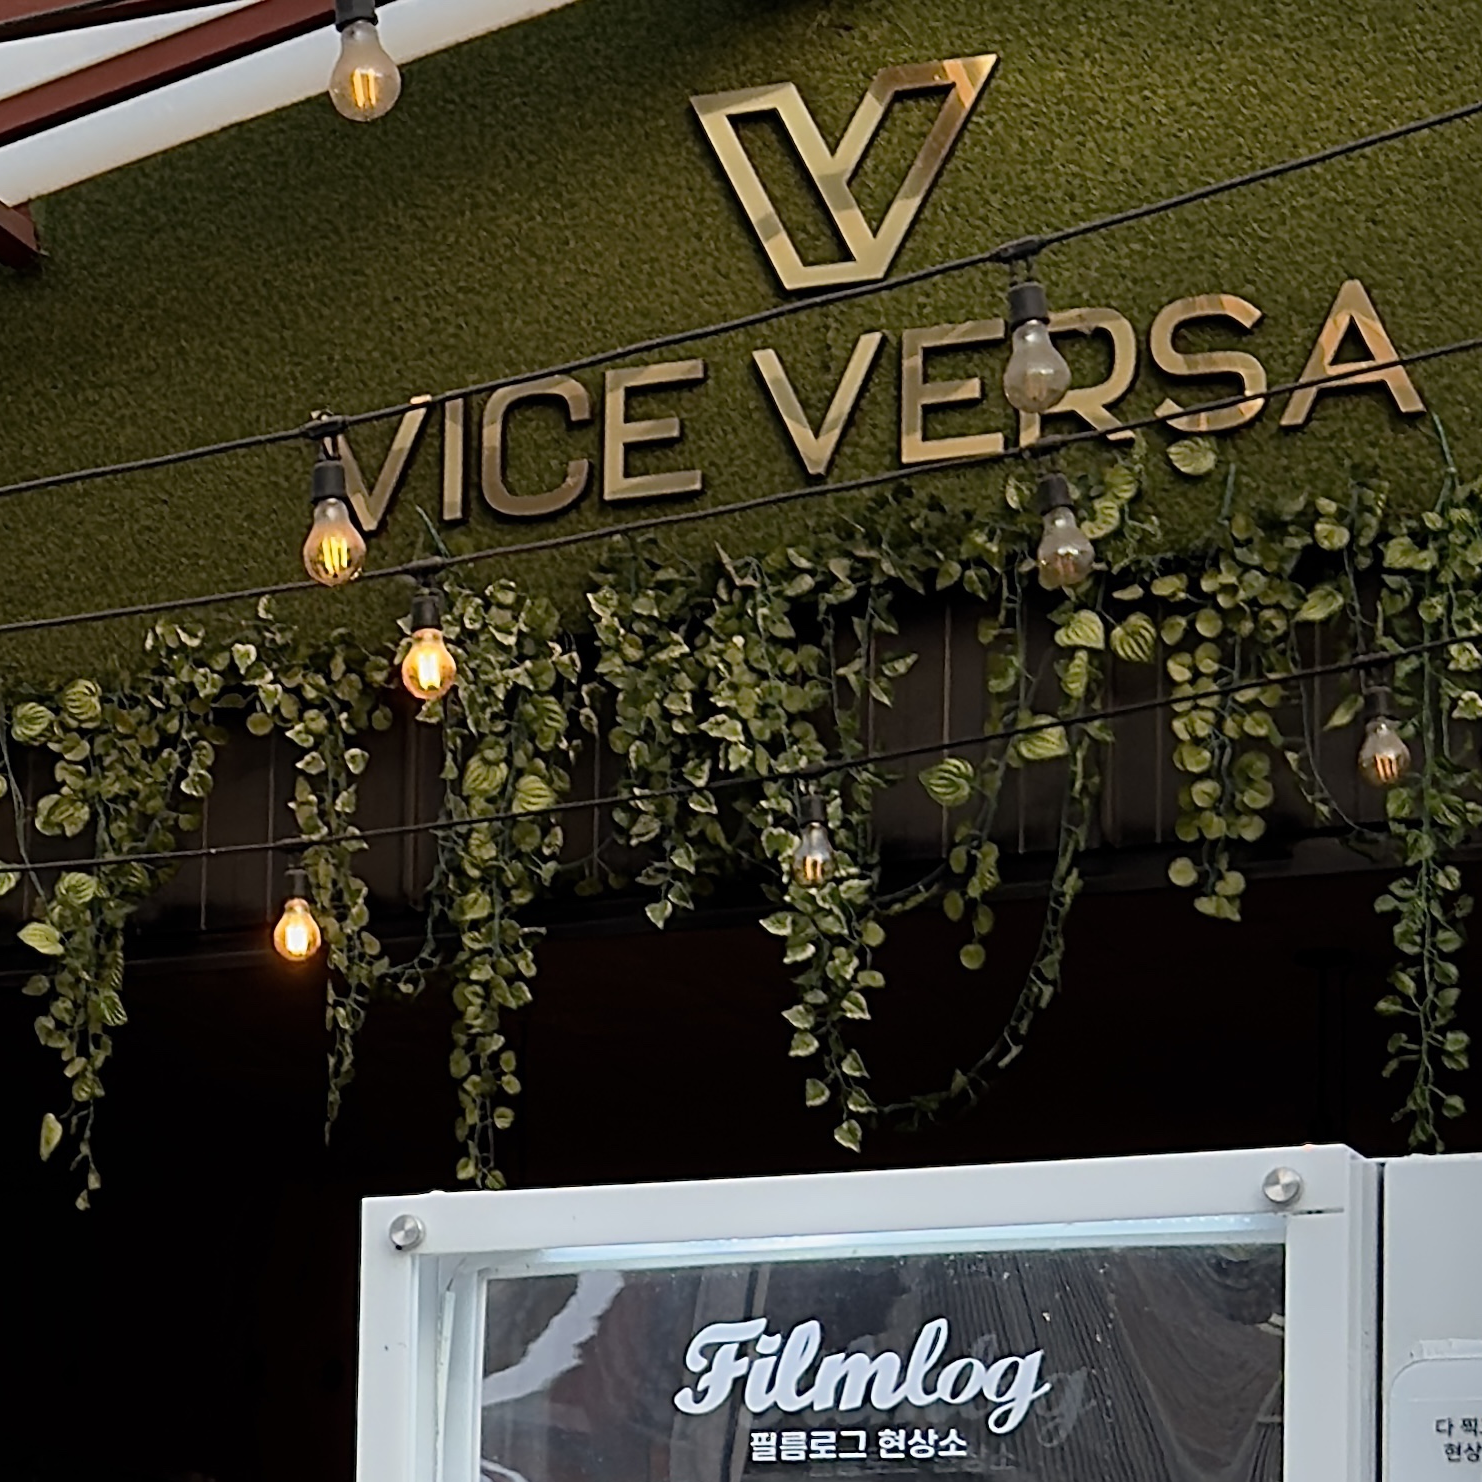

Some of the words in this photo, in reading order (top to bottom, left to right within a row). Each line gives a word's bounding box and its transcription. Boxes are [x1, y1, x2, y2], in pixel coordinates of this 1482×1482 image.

[315, 358, 705, 532] VICE
[752, 279, 1427, 477] VERSA
[673, 1317, 1052, 1434] Filmlog
[749, 1429, 868, 1462] 필름로그
[877, 1427, 968, 1459] 현상소
